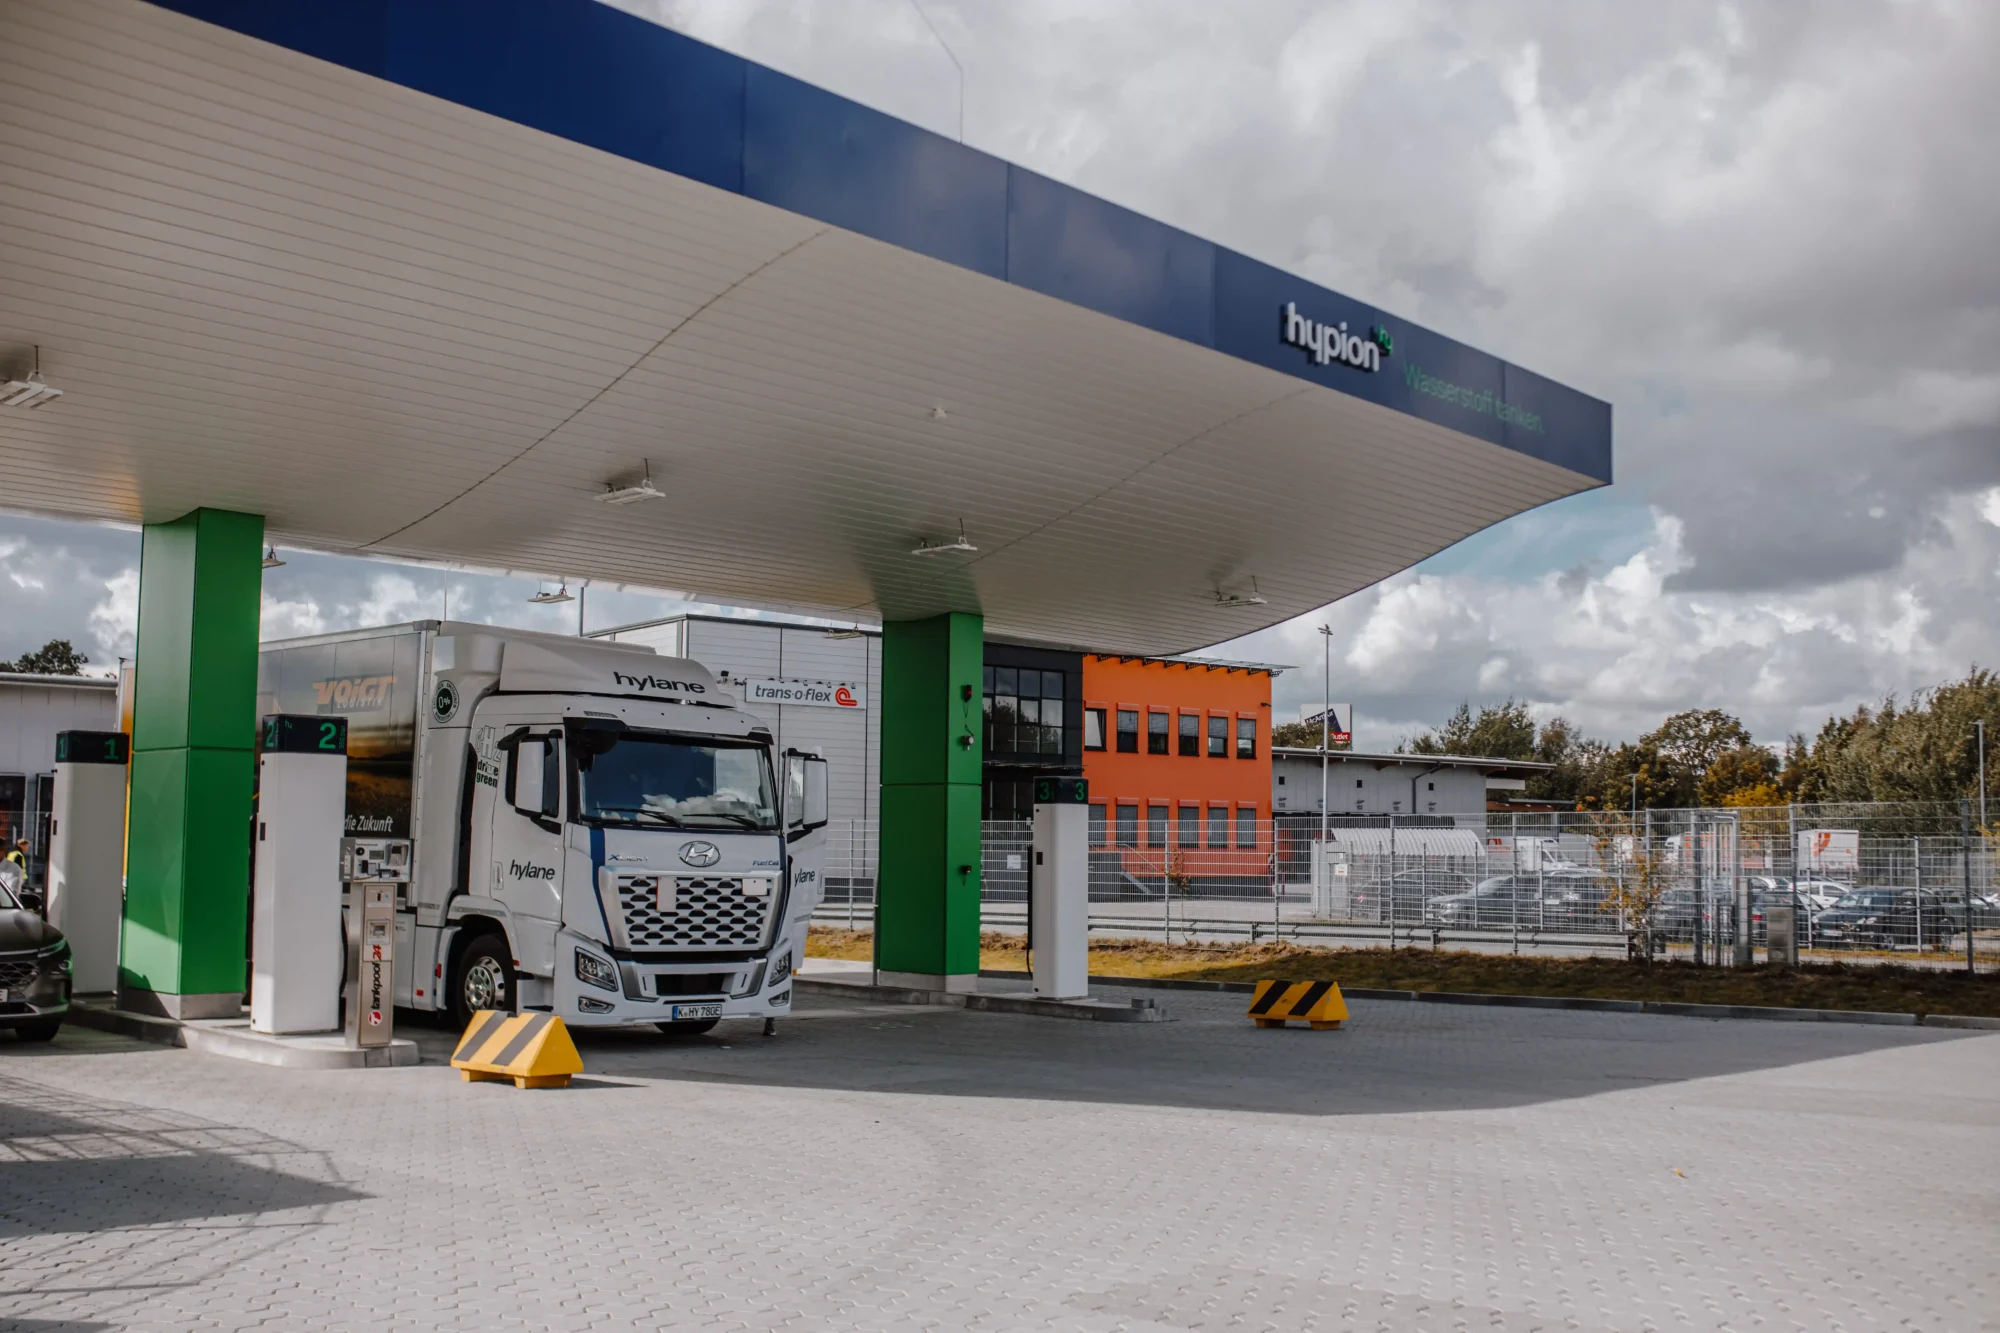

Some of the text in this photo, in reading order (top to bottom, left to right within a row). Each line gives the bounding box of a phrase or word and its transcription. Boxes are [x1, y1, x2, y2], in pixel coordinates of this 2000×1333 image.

[1287, 301, 1380, 372] hypion
[613, 671, 706, 694] hylane
[319, 722, 337, 749] 2
[103, 738, 119, 760] 1
[476, 772, 498, 788] green
[1039, 782, 1050, 800] 3
[1075, 782, 1085, 801] 3
[357, 815, 394, 832] Zukunft
[509, 859, 556, 880] hylane
[794, 868, 816, 887] ylane
[371, 944, 383, 1010] tankpool24
[688, 1007, 700, 1016] HY
